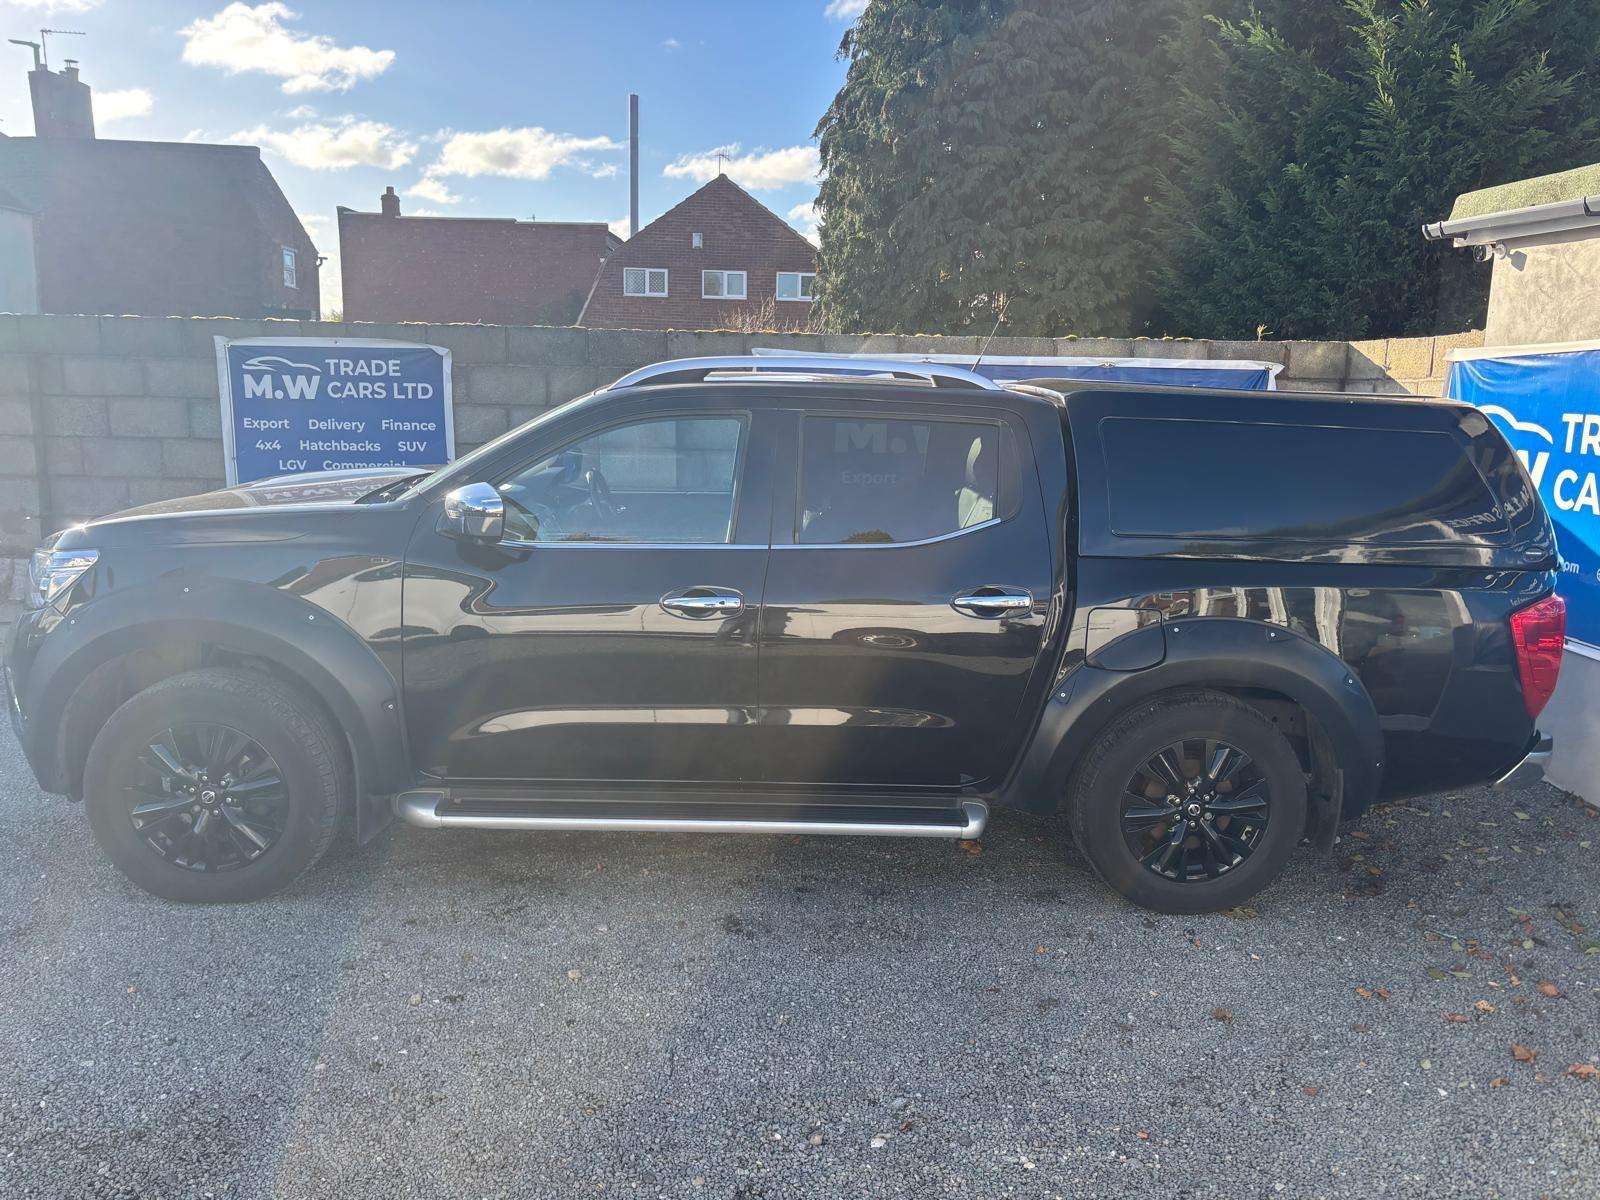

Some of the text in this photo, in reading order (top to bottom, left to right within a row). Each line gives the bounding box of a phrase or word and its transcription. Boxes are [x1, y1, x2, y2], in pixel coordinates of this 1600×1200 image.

[325, 359, 401, 377] TRADE
[242, 373, 321, 400] M.W
[327, 382, 434, 400] CARS LTD
[243, 418, 436, 432] Export Delivery Finance
[255, 440, 427, 452] 4x4 Hatchbacks SUV
[279, 460, 307, 471] LGV
[841, 471, 897, 485] Export
